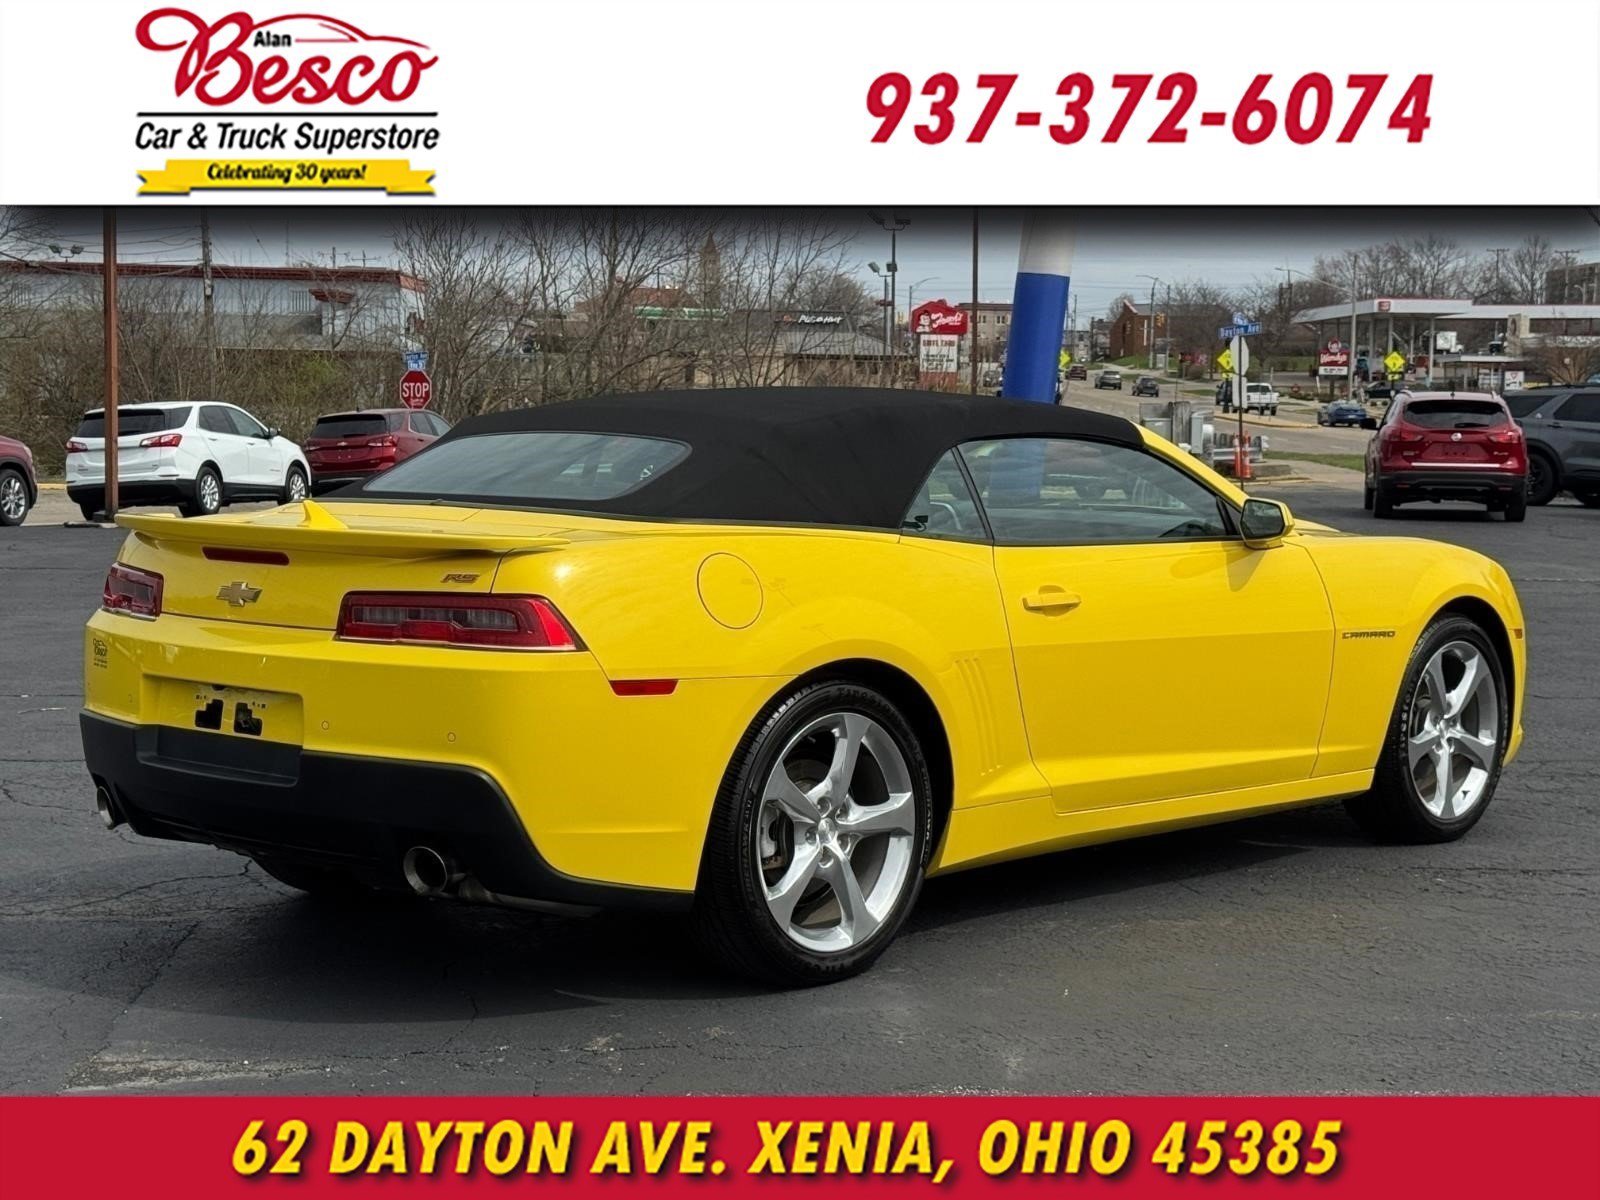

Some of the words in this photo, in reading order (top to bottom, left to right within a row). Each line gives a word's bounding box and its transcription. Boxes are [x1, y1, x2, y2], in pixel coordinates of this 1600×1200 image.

[402, 382, 430, 398] STOP
[440, 573, 481, 584] RS
[1341, 630, 1396, 640] CAMARO
